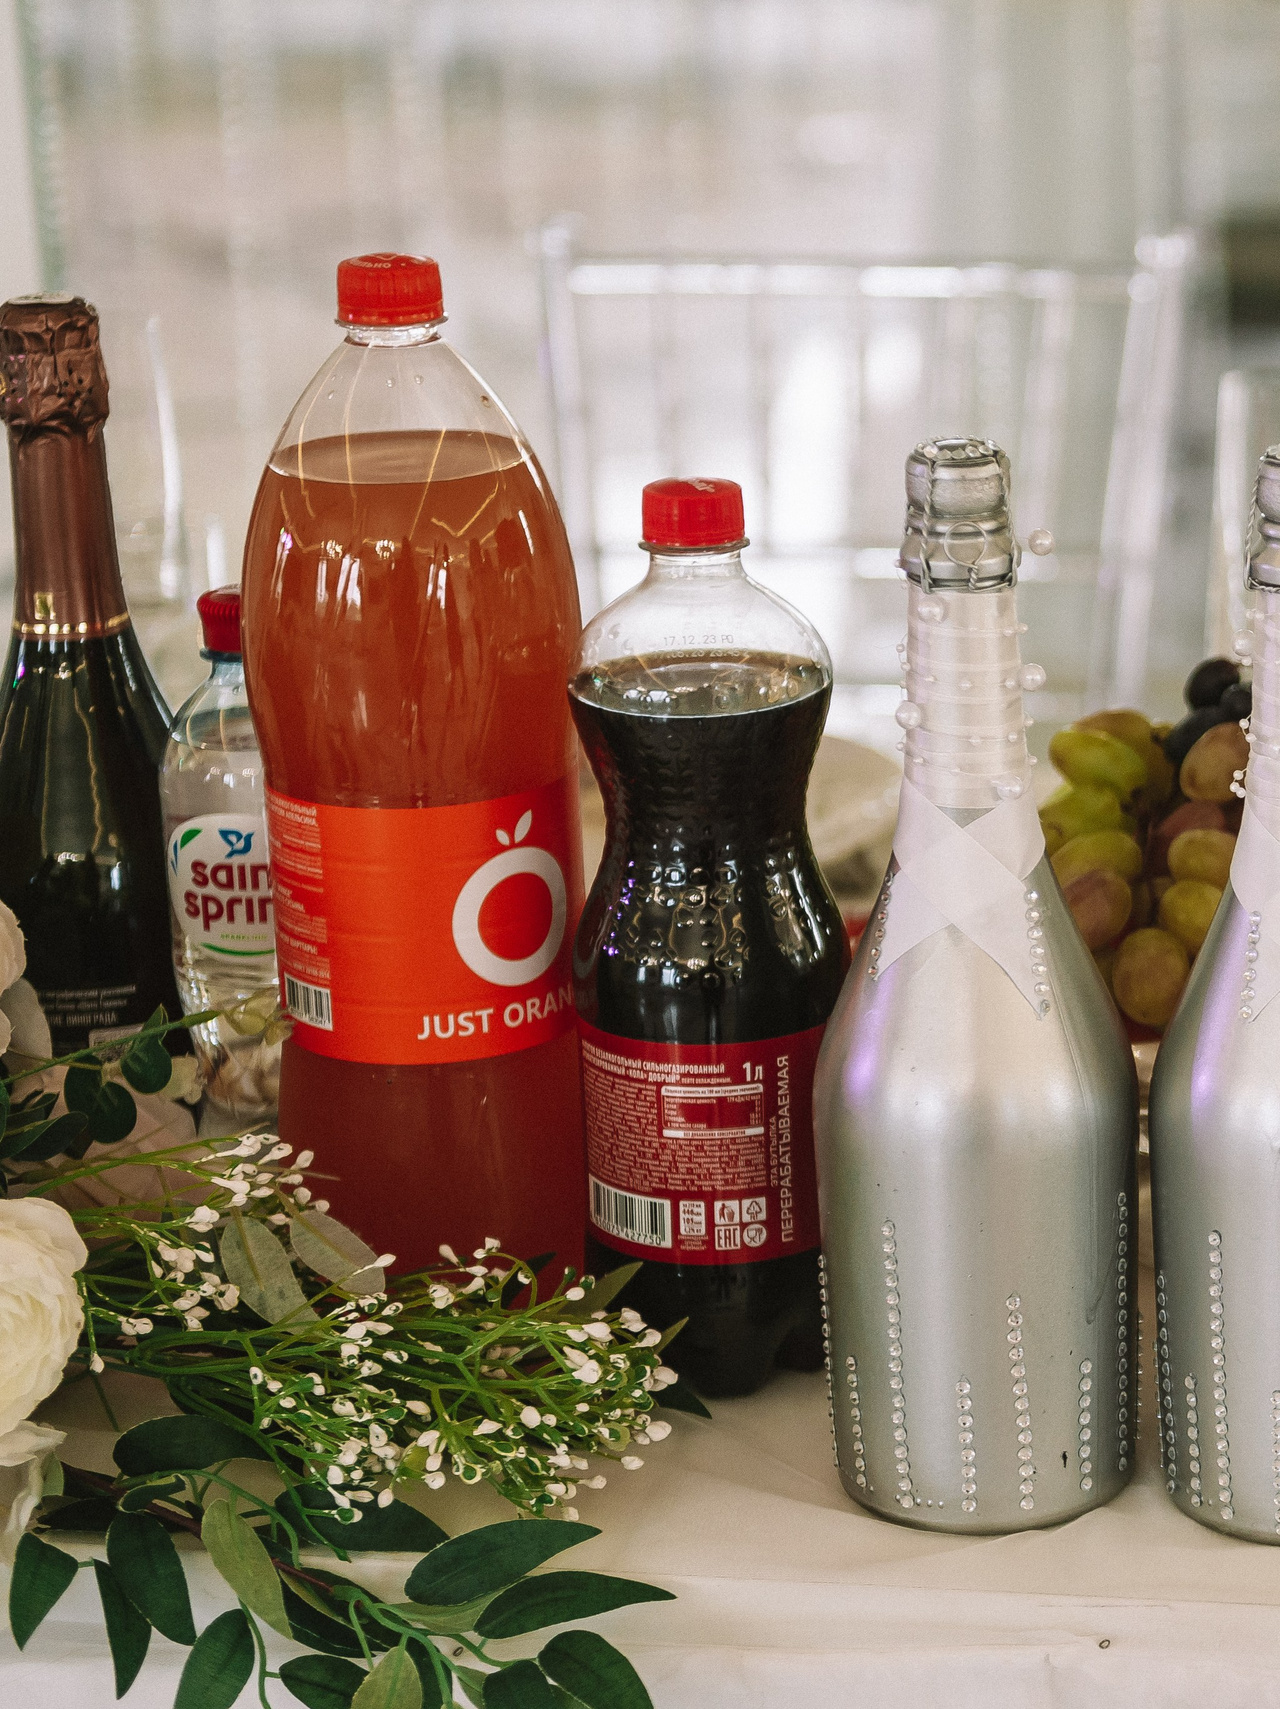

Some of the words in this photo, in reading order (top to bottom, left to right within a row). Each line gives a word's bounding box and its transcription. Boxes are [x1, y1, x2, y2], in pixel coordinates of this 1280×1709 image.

[417, 1007, 494, 1041] JUST
[643, 1060, 725, 1075] СИЛЬНОГАЗИРОВАННЫЙ
[742, 1061, 751, 1082] 1
[777, 1054, 794, 1243] ПЕРЕРАБАТЫВАЕМАЯ
